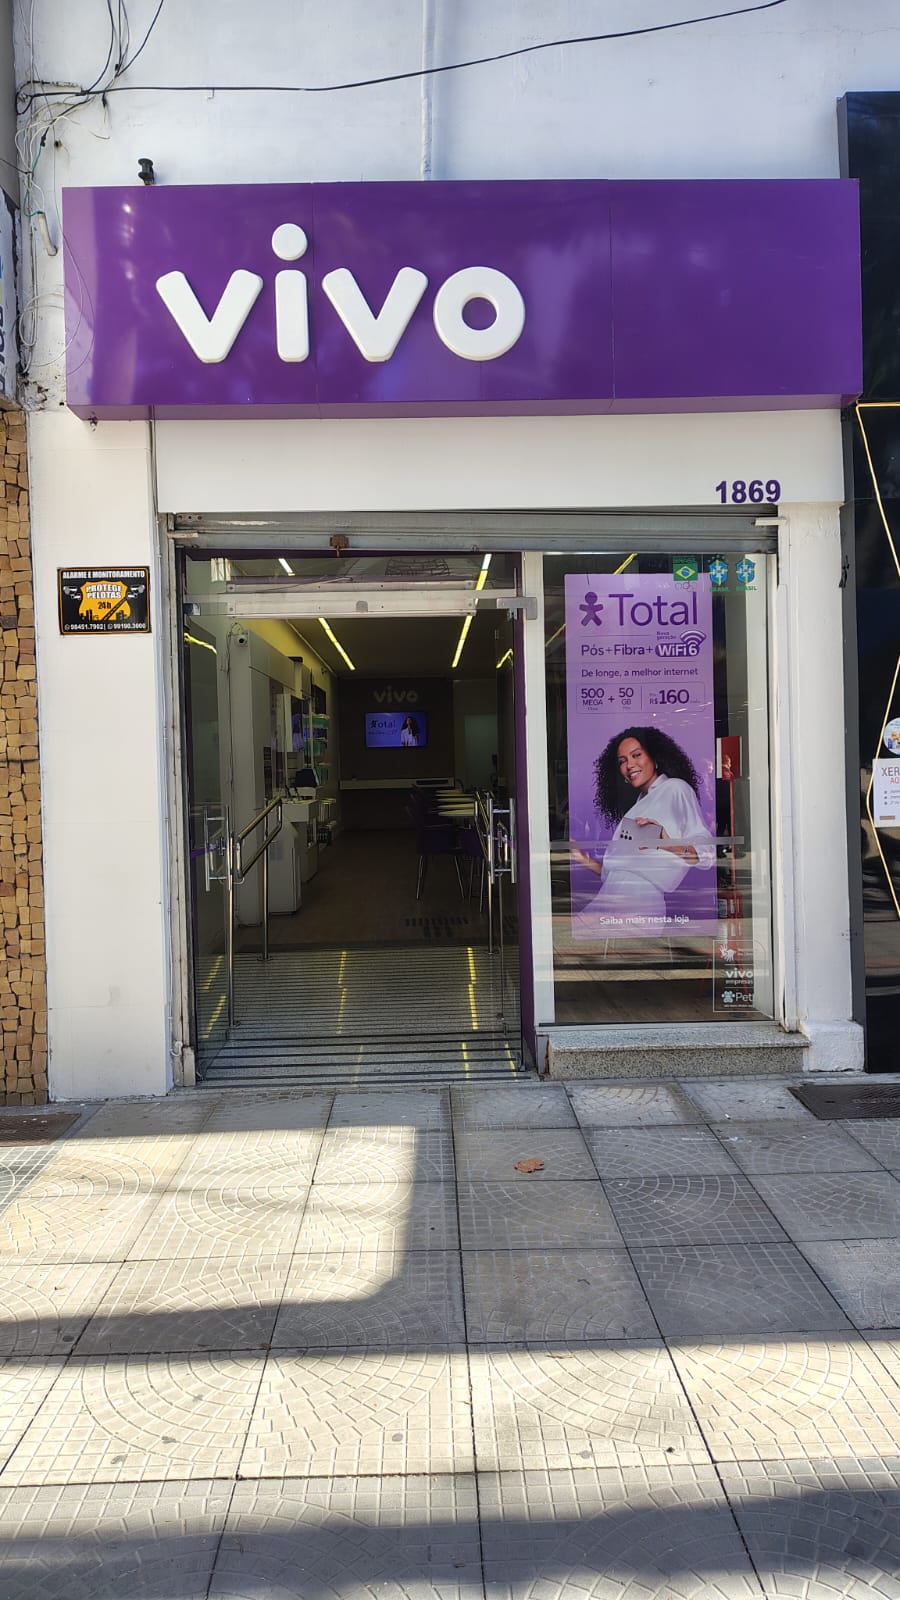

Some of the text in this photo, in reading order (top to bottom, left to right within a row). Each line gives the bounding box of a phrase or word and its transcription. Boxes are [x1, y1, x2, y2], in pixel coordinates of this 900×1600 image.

[155, 223, 526, 363] vivo
[715, 480, 782, 505] 1869
[62, 571, 87, 579] ALARME
[92, 570, 145, 578] MONITORAMENTO
[608, 592, 698, 627] Total
[581, 669, 593, 678] De
[595, 668, 622, 679] longe,
[631, 668, 662, 677] melhor
[664, 667, 698, 676] internet
[373, 686, 418, 703] vivo
[581, 687, 605, 699] 500
[618, 687, 634, 698] 50
[621, 698, 632, 706] GB
[599, 914, 690, 926] Saiba mais nesta loja
[725, 967, 753, 978] vivo
